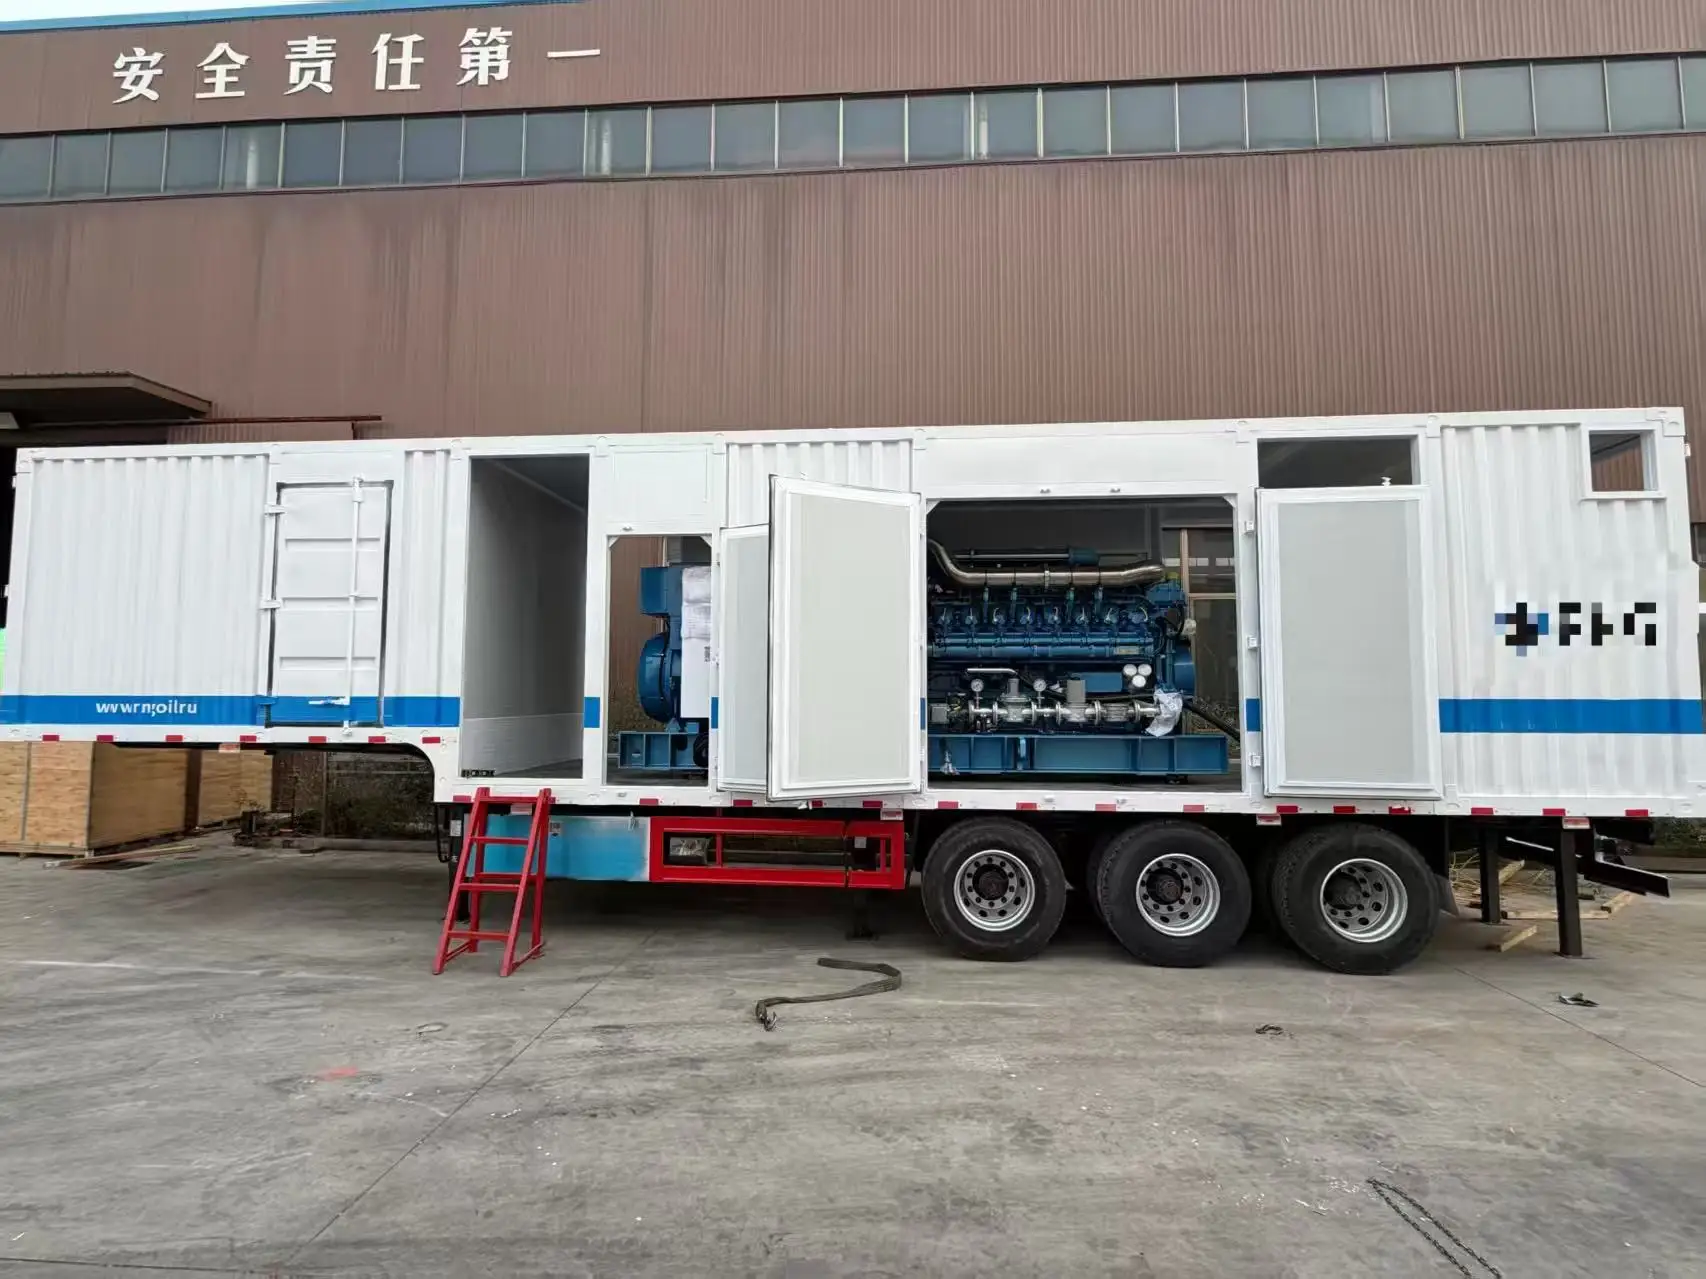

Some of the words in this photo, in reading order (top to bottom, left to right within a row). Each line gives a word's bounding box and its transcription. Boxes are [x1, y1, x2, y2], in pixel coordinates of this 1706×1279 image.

[112, 27, 601, 104] 安全责任第一
